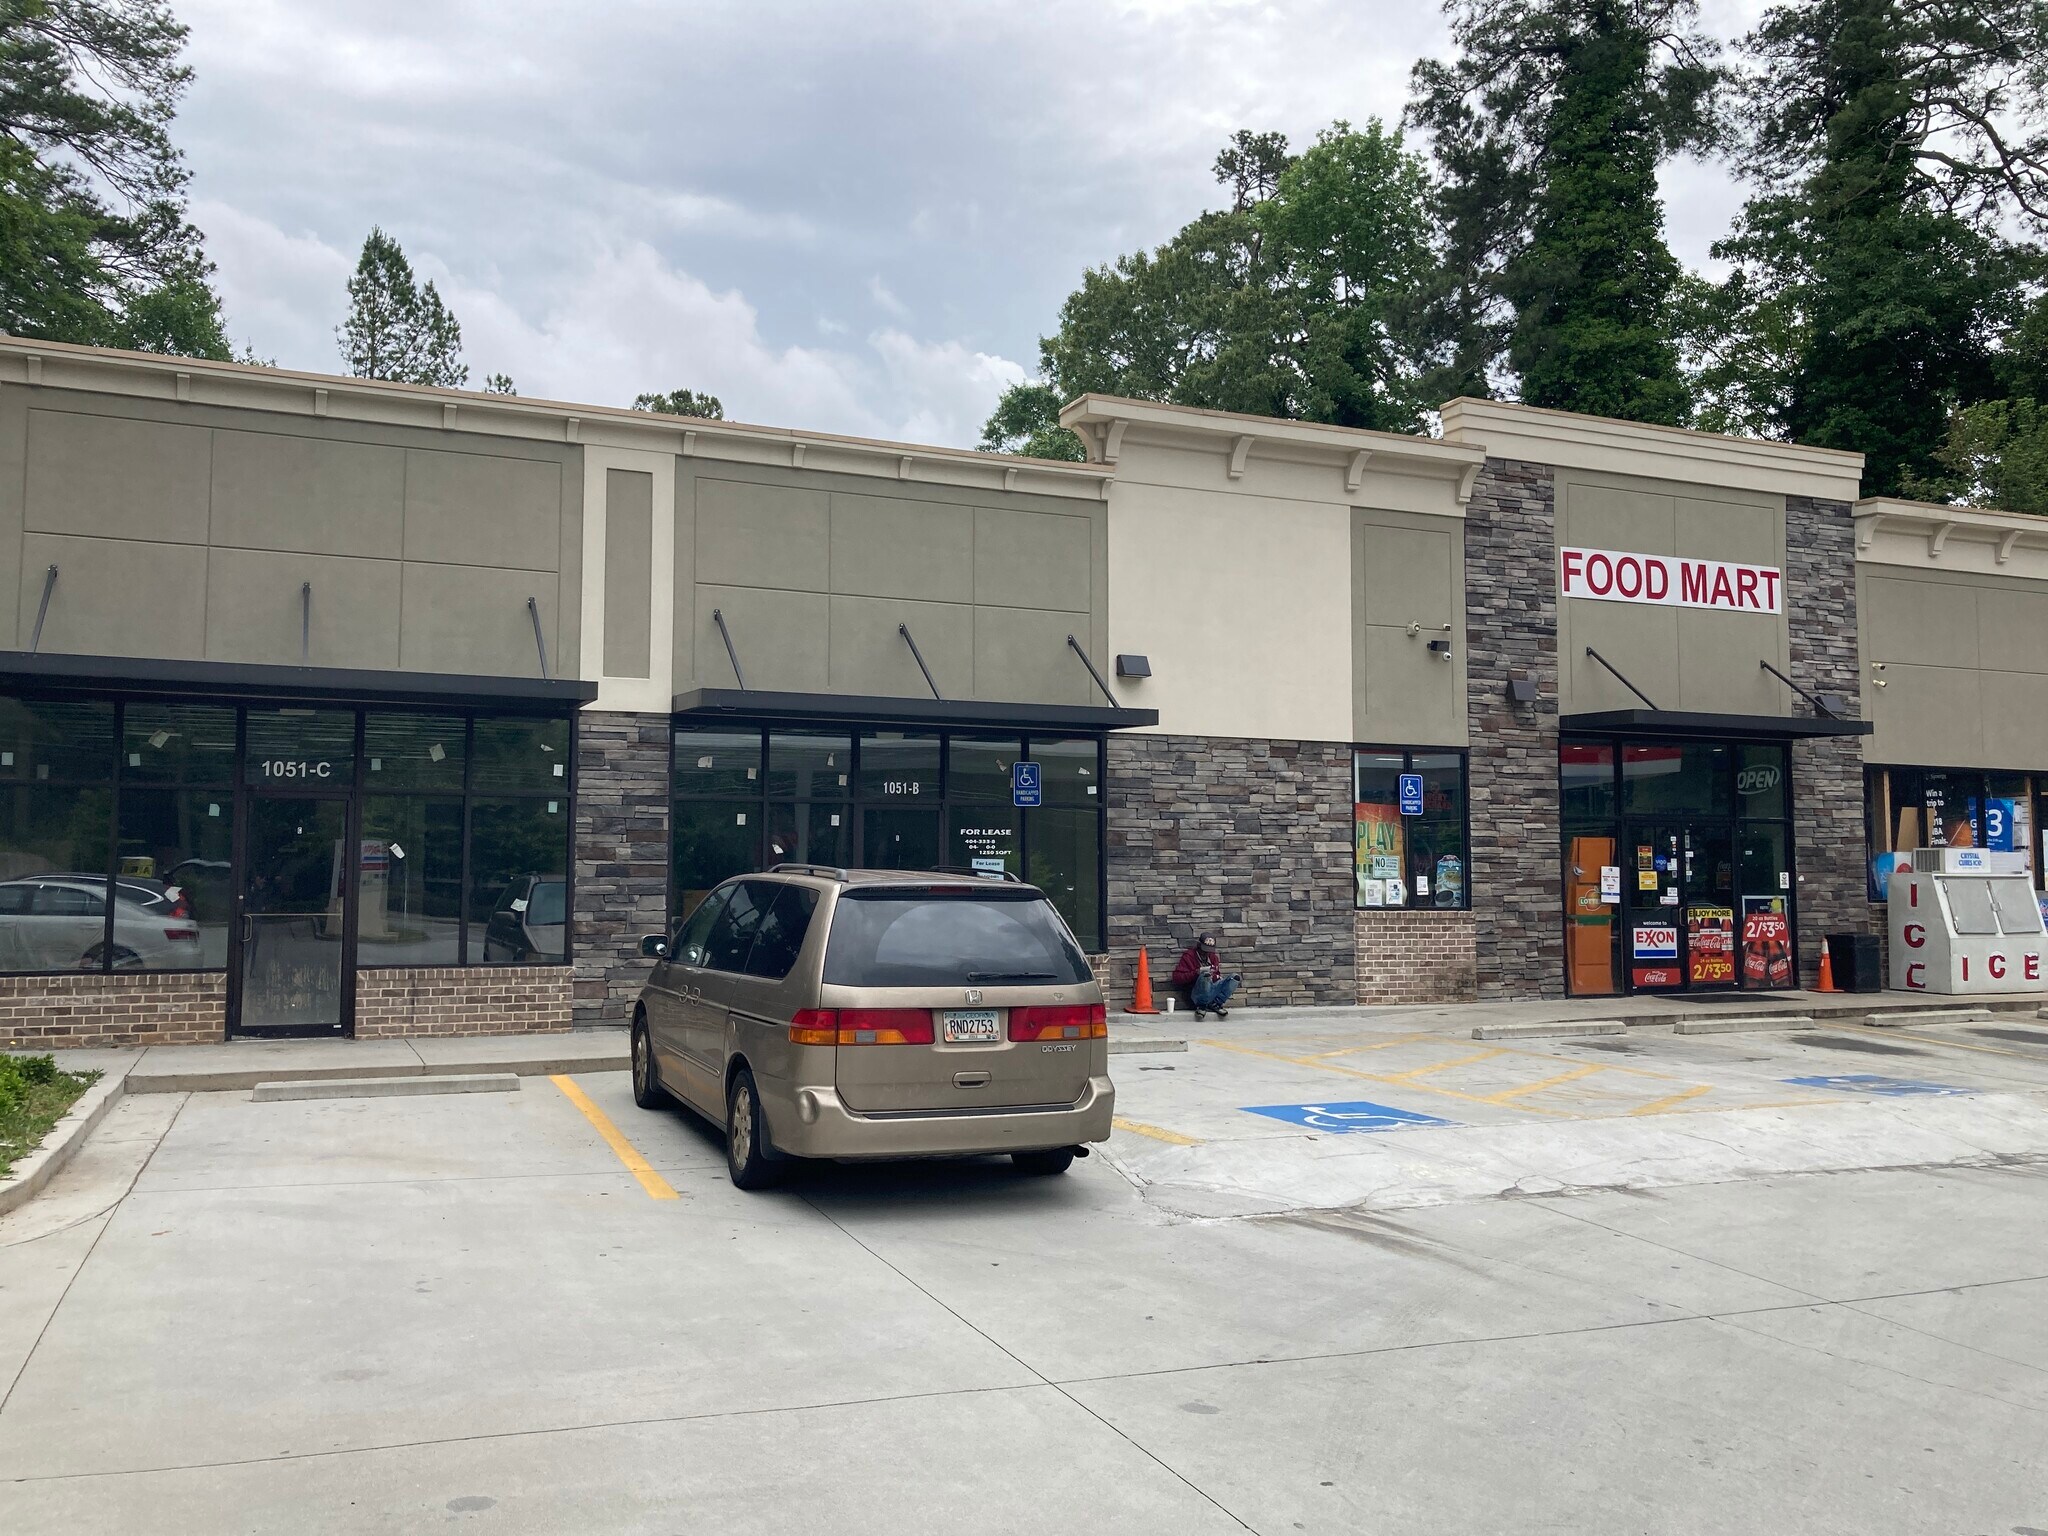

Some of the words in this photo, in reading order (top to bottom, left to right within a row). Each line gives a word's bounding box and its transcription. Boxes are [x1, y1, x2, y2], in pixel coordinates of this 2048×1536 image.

[1562, 551, 1669, 600] FOOD
[1681, 562, 1780, 610] MART
[261, 760, 331, 778] 1051-C
[1737, 770, 1775, 789] OPEN
[883, 781, 920, 795] 1051-B
[1926, 789, 1938, 797] Win
[960, 828, 981, 836] FOR
[982, 828, 1012, 836] LEASE
[1356, 821, 1396, 850] PLAY
[1375, 857, 1386, 868] NO
[1711, 909, 1731, 917] MORE
[1636, 929, 1675, 948] EXXON
[1962, 951, 2040, 982] ICE
[950, 1019, 994, 1034] RND2753
[1041, 1044, 1077, 1053] ODYSSEY
